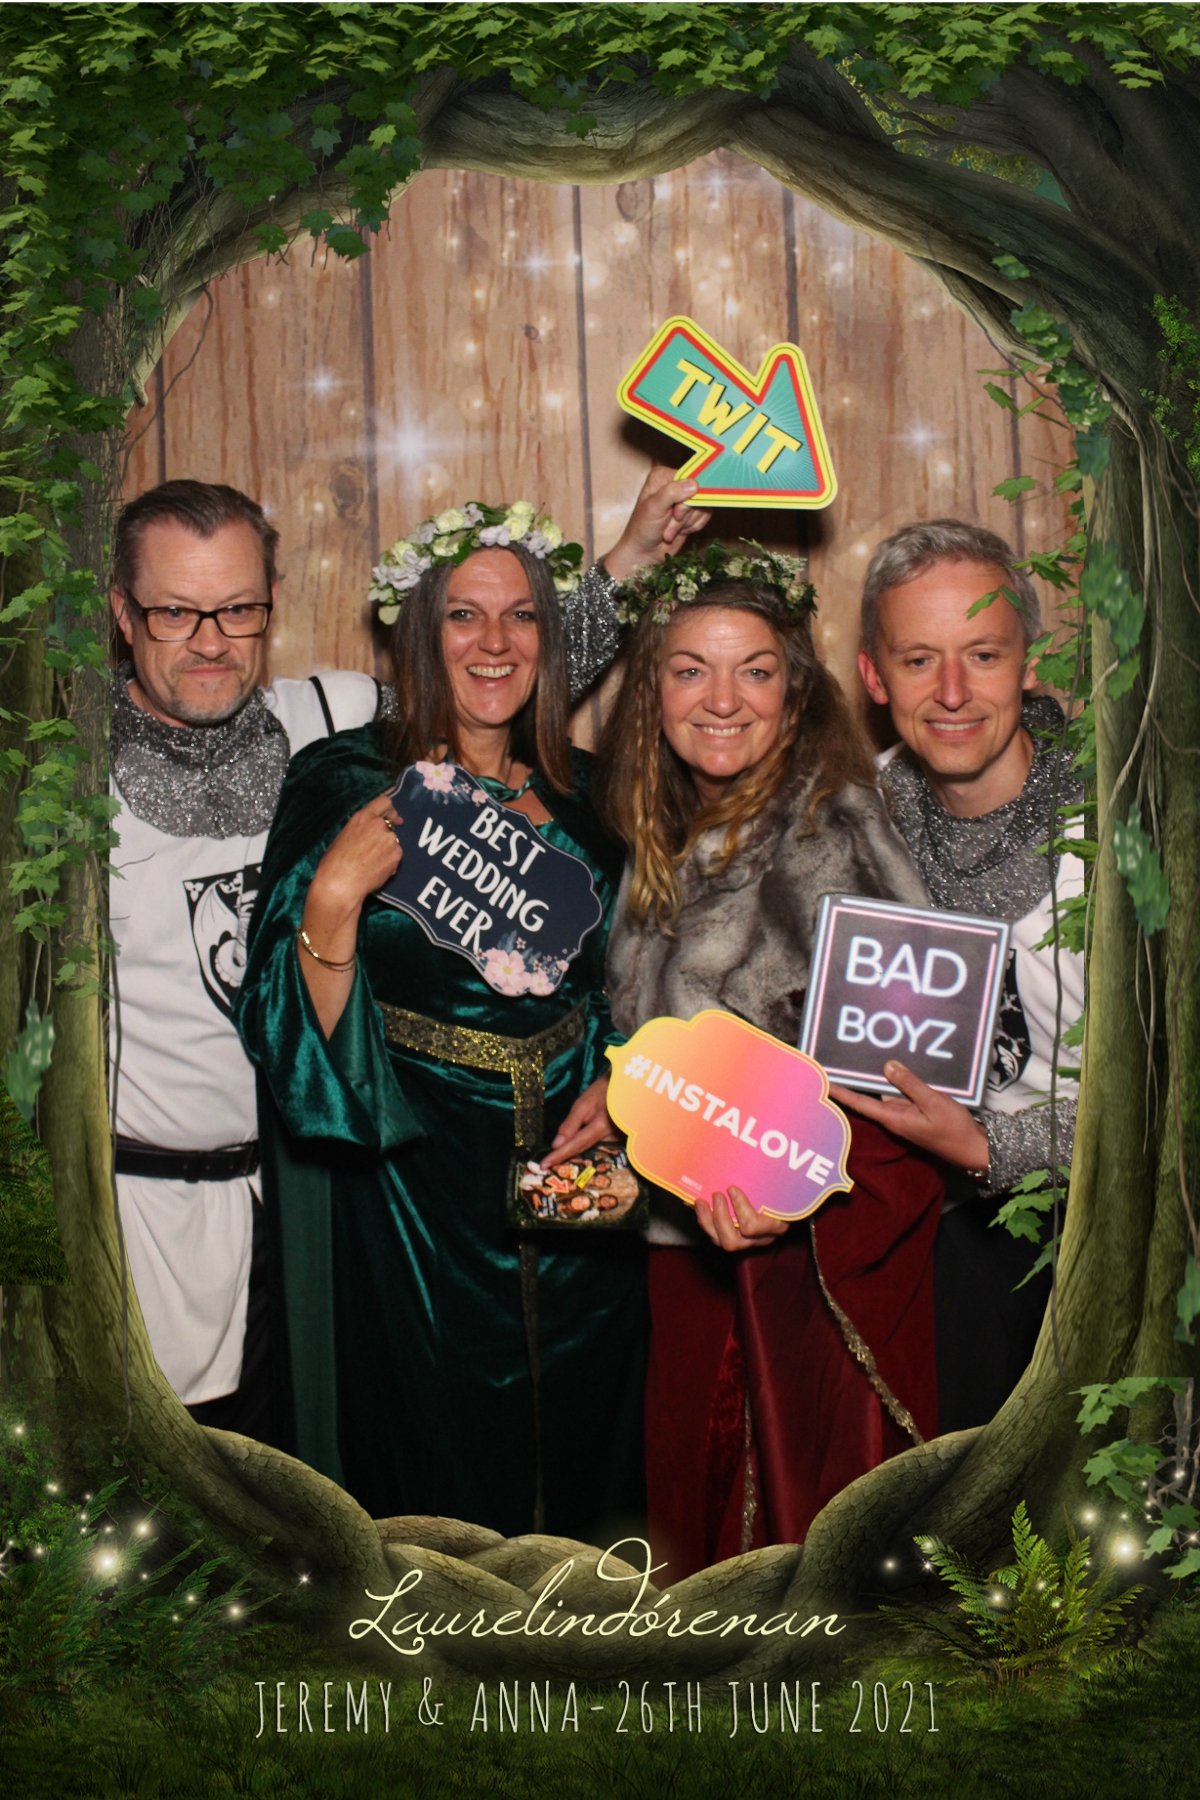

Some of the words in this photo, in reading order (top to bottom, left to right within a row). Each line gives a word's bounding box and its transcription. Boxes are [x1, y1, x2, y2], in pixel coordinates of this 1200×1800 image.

[669, 358, 803, 474] TWIT
[418, 817, 549, 932] WEDDING
[469, 806, 546, 875] BEST
[417, 876, 493, 954] EVER
[846, 935, 968, 998] BAD
[837, 1005, 957, 1059] BOYZ
[623, 1054, 835, 1186] #INSTALOVE
